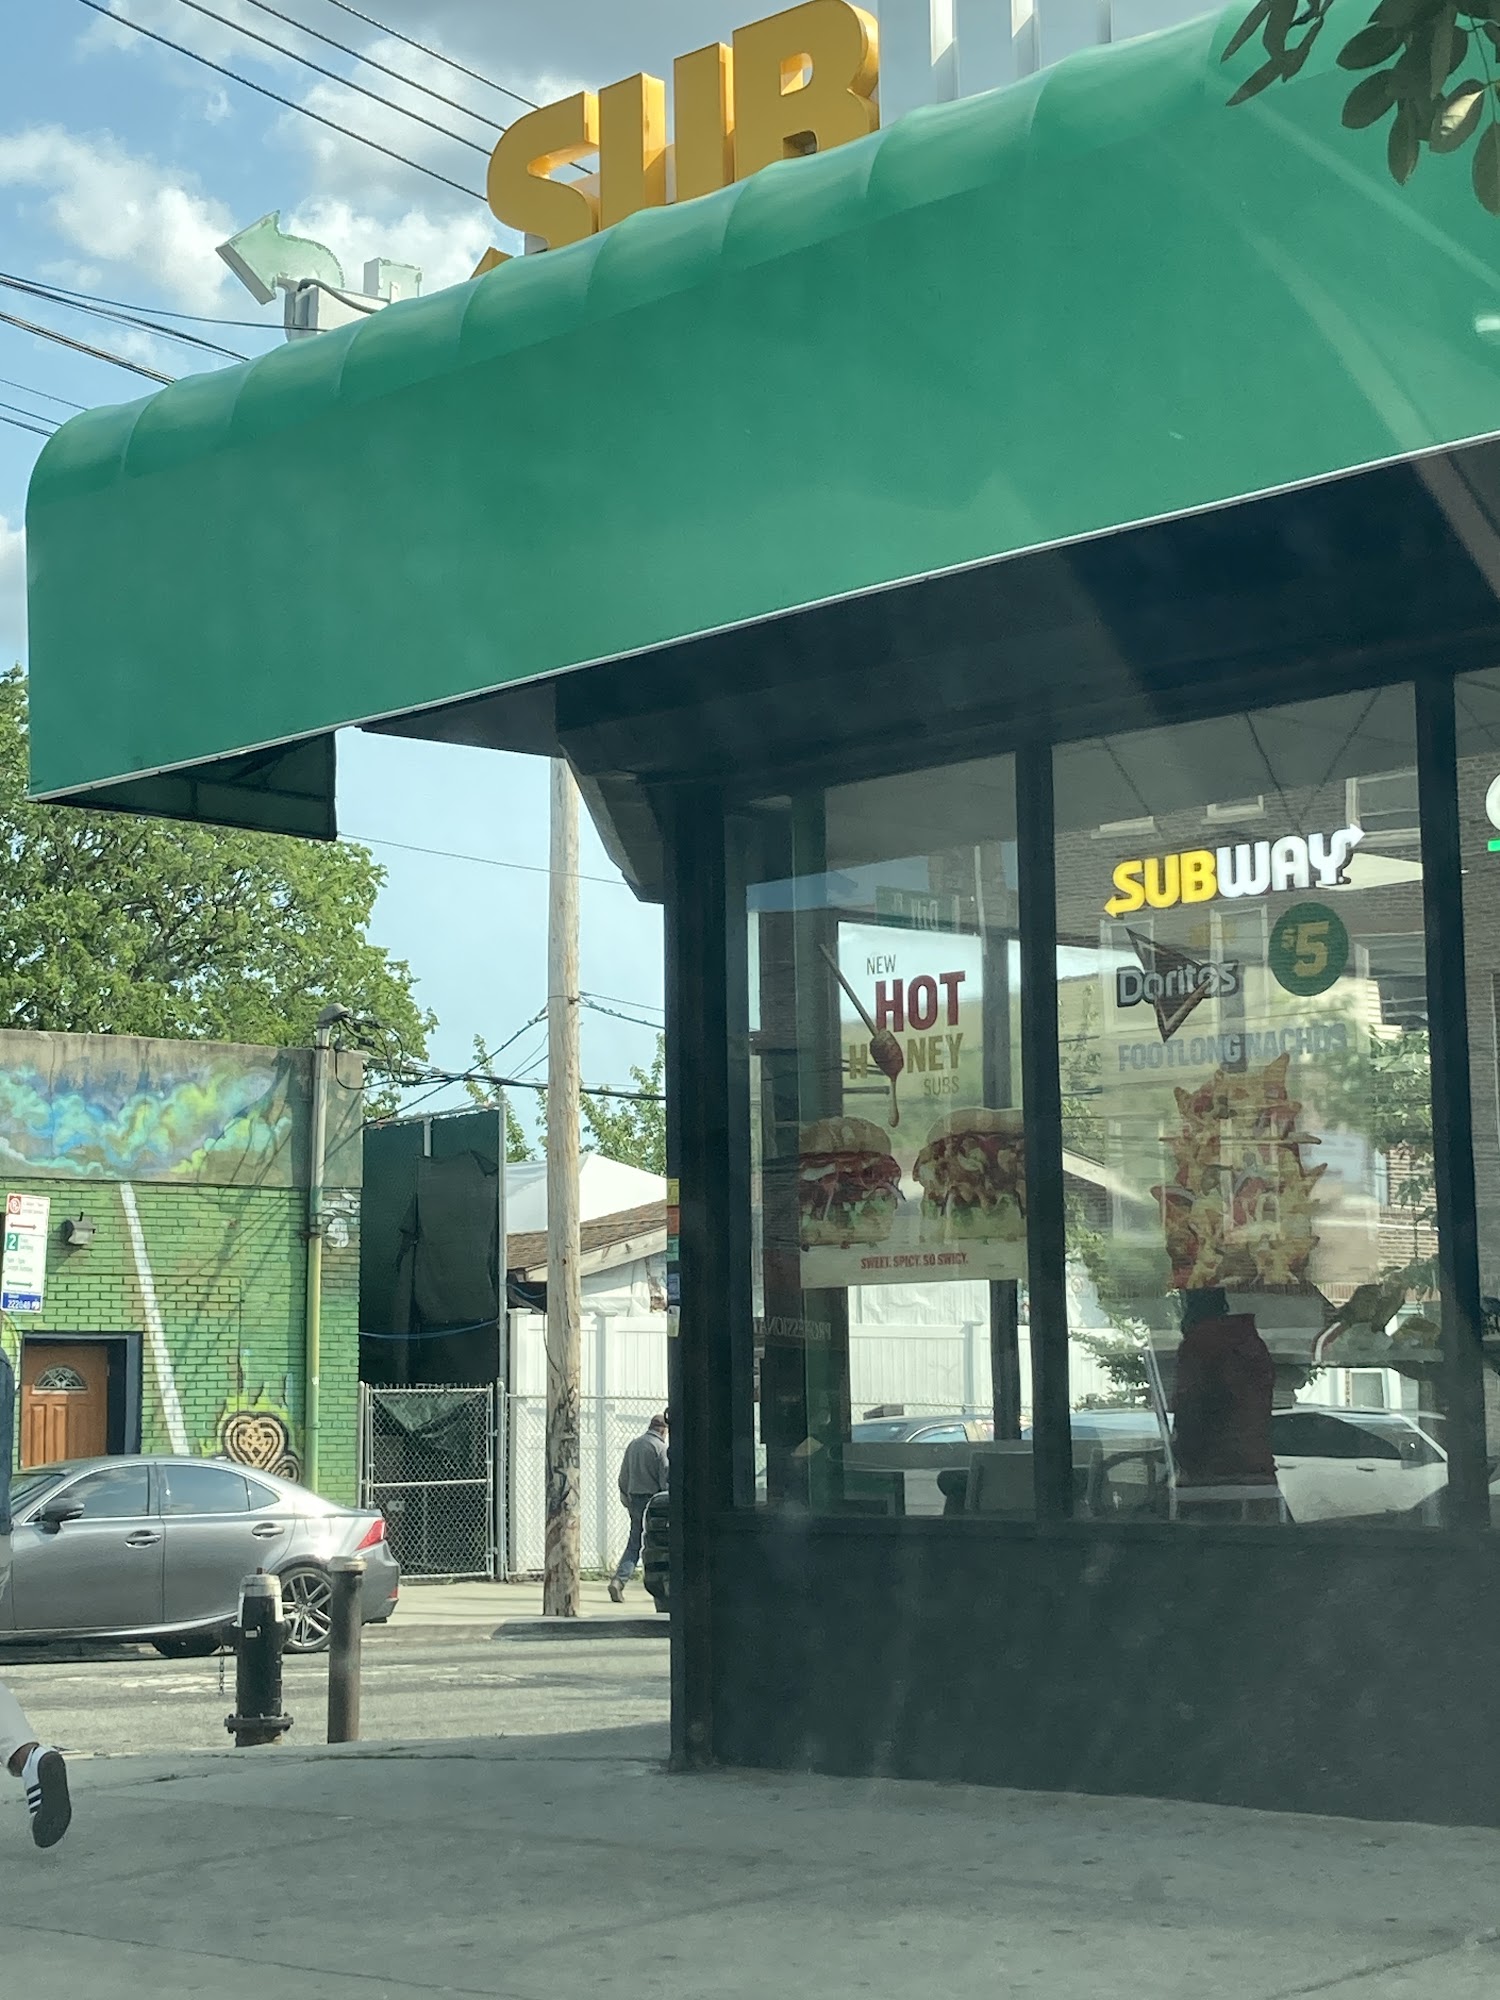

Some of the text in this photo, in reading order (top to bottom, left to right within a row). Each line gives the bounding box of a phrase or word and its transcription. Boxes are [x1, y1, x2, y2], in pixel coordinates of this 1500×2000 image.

[1104, 824, 1365, 917] SUBWAY
[867, 954, 896, 975] NEW
[1118, 960, 1238, 1005] Doritos
[875, 971, 966, 1032] HOT
[849, 1032, 963, 1080] HNEY
[1118, 1022, 1348, 1072] FOOTLONG NACHOS
[923, 1076, 960, 1096] SUBS
[8, 1233, 17, 1250] 2
[923, 1254, 936, 1266] SO
